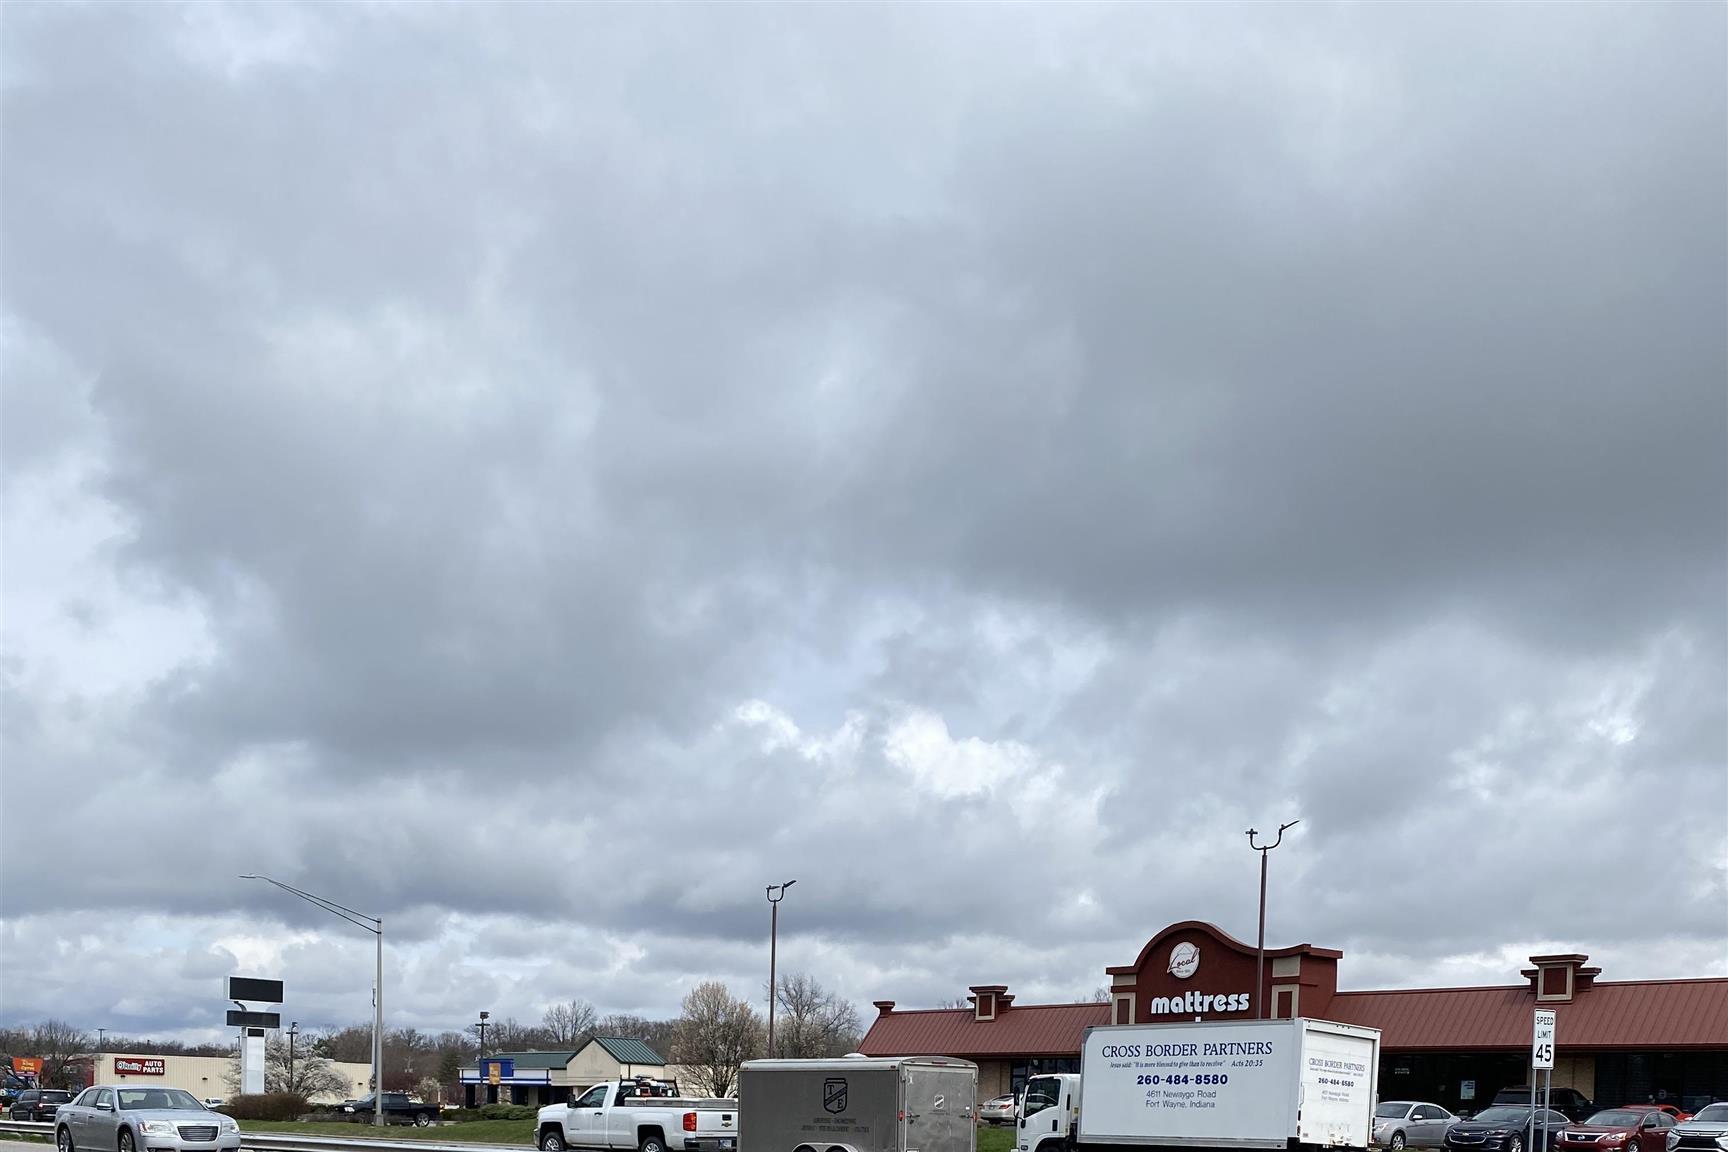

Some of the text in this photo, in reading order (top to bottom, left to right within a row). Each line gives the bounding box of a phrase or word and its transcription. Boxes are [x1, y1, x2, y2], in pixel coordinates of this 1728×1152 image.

[1166, 947, 1200, 973] Local
[1151, 991, 1250, 1014] mattress
[1536, 1016, 1554, 1026] SPEED
[1537, 1030, 1552, 1039] LIMIT
[1102, 1041, 1273, 1058] CROSS BORDER PARTNERS
[1535, 1043, 1552, 1063] 45
[1245, 1059, 1264, 1067] 20:35
[142, 1066, 164, 1074] PARTS
[1137, 1074, 1229, 1085] 260-484-8580
[827, 1084, 834, 1095] T
[1146, 1090, 1217, 1099] 4611 Newaygo Road
[837, 1098, 843, 1109] E
[1146, 1100, 1216, 1109] Fort Wayne, Indiana
